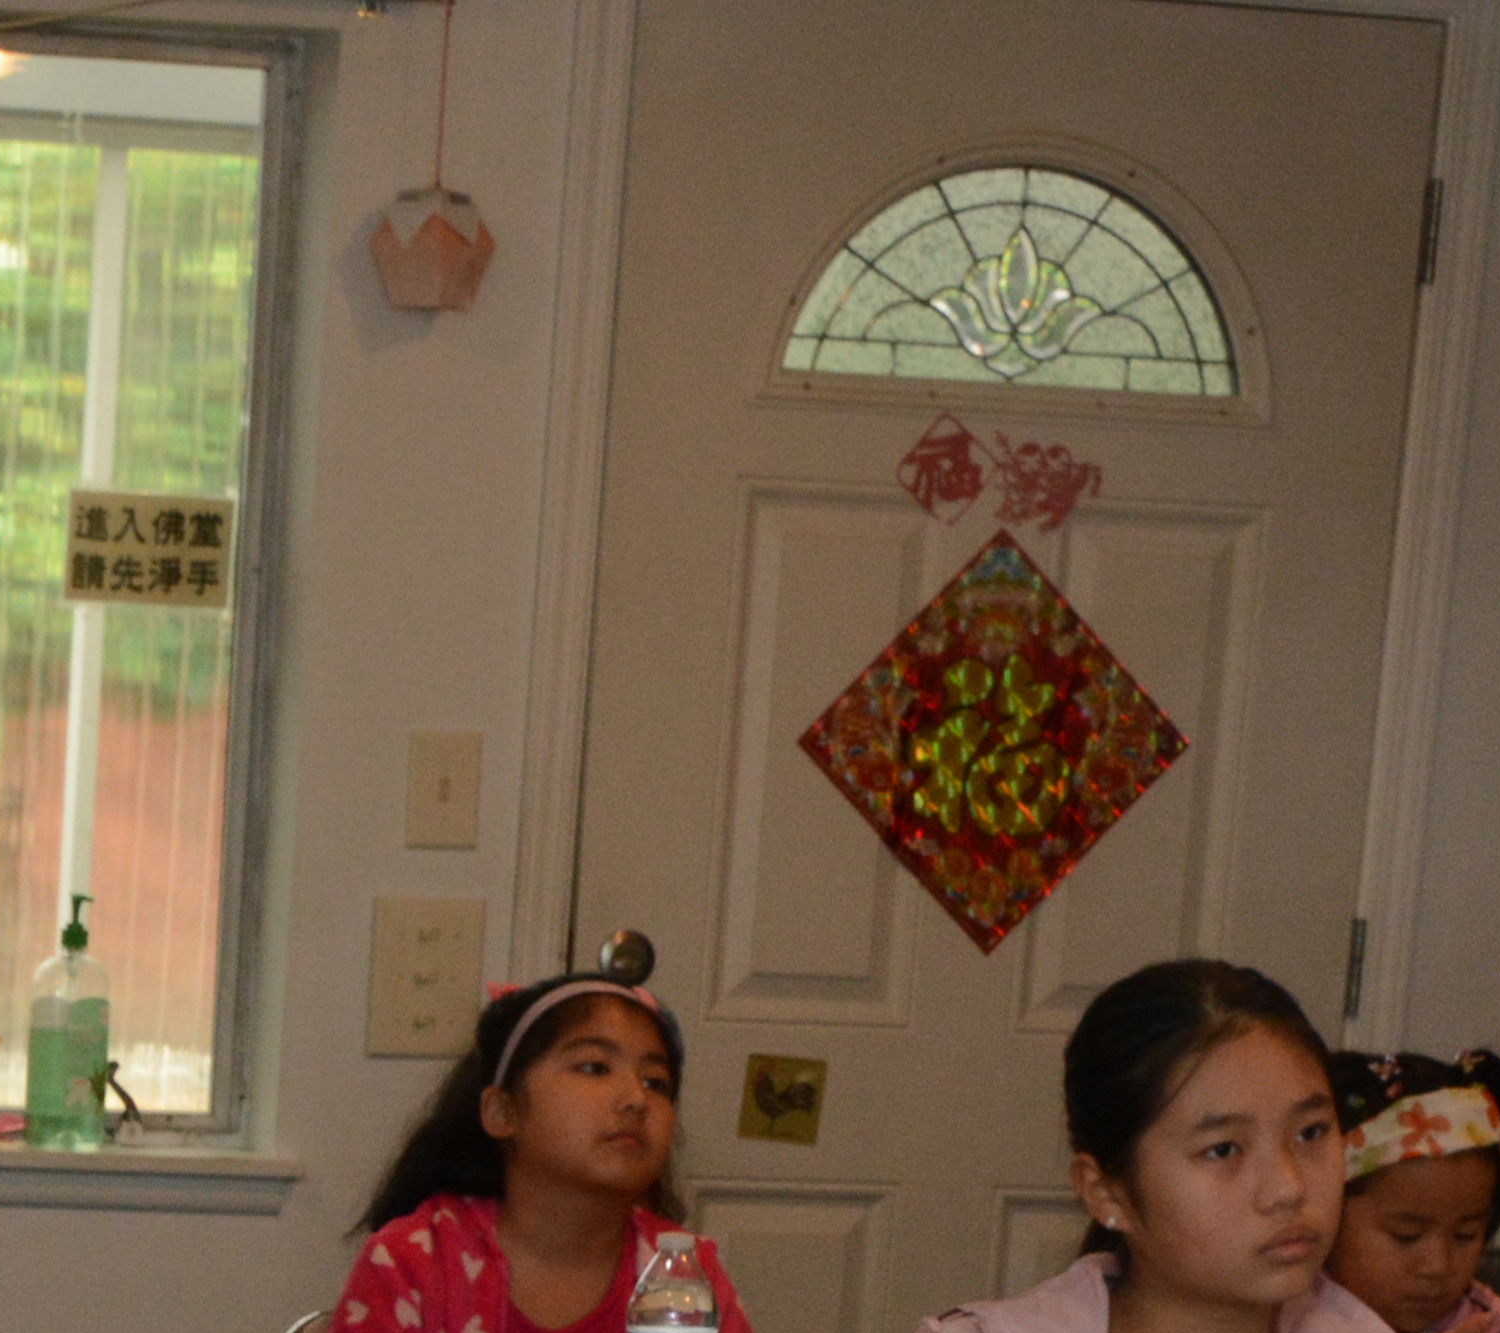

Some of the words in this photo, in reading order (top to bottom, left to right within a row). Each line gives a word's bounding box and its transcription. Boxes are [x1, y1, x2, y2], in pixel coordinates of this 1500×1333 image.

[73, 504, 223, 549] 進入佛堂
[70, 550, 221, 596] 請先淨手
